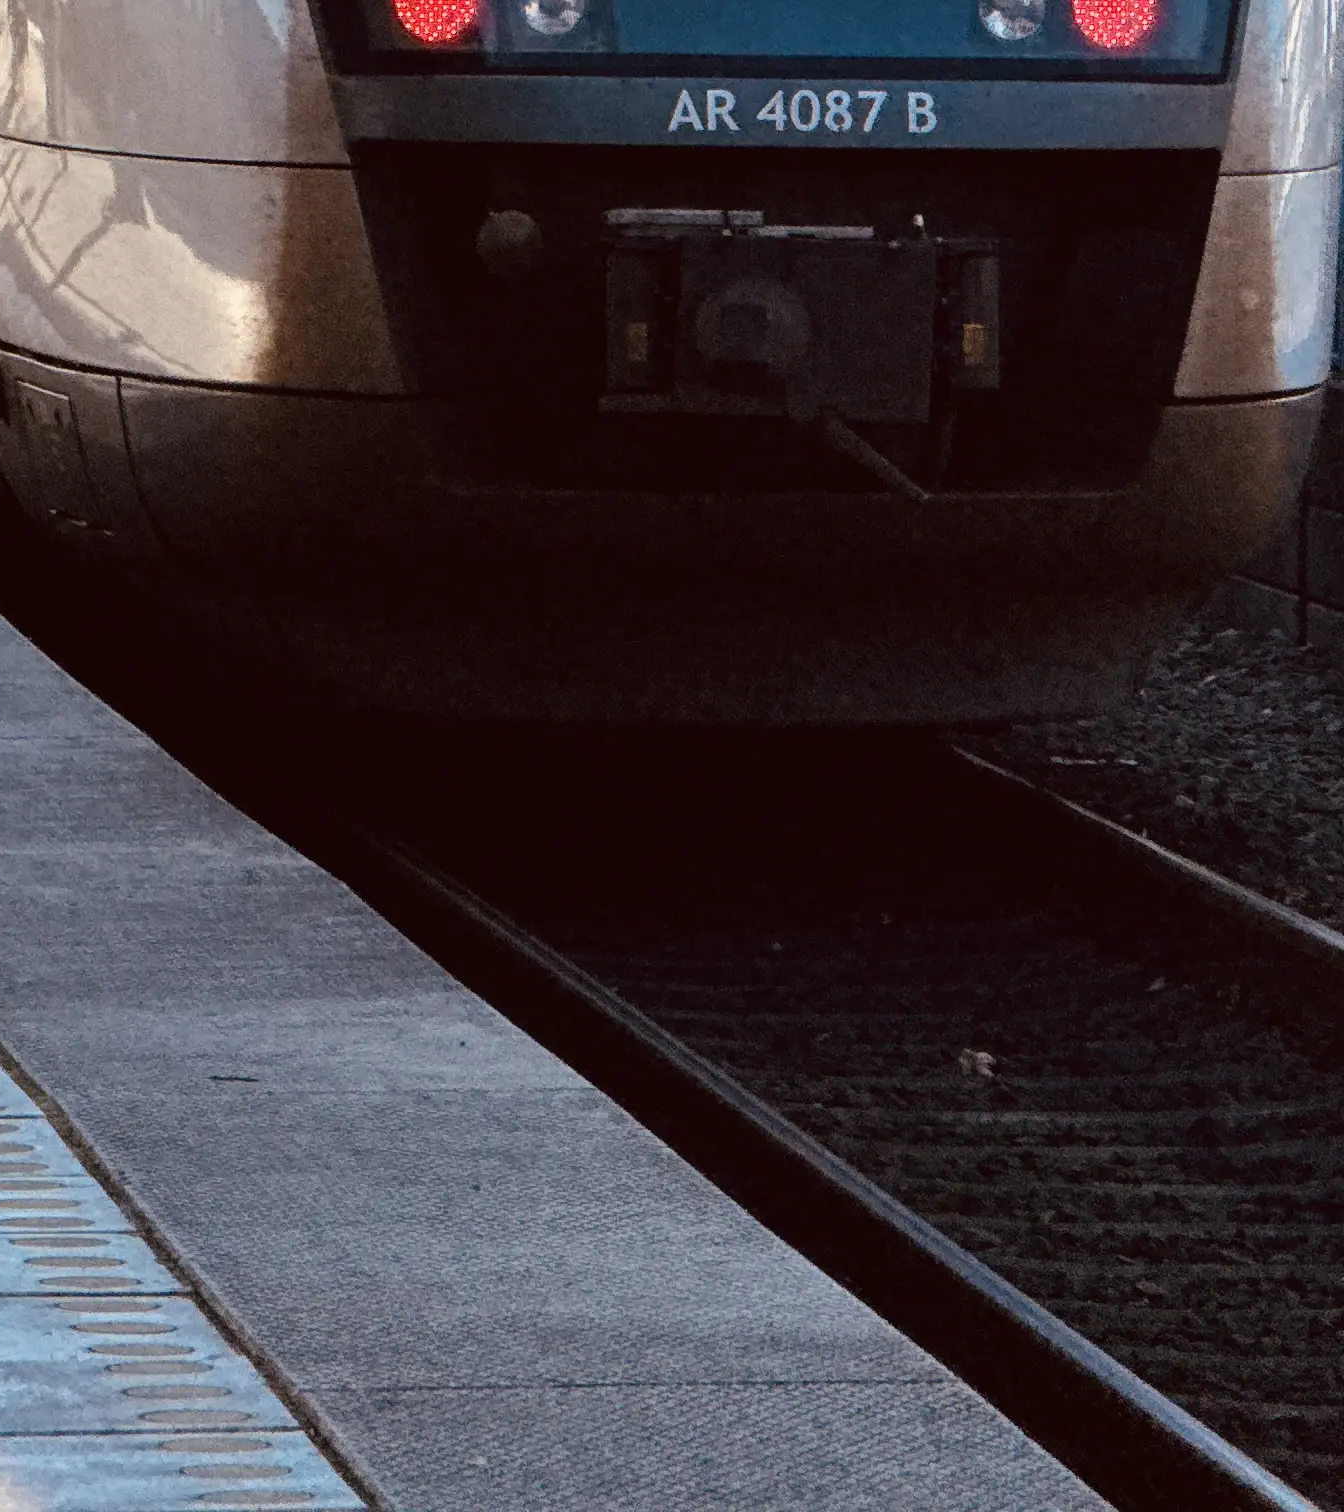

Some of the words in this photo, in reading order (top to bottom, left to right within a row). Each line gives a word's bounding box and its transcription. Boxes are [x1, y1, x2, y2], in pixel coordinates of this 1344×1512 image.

[667, 89, 740, 132] AR
[756, 89, 888, 133] 4087
[907, 90, 938, 133] B
